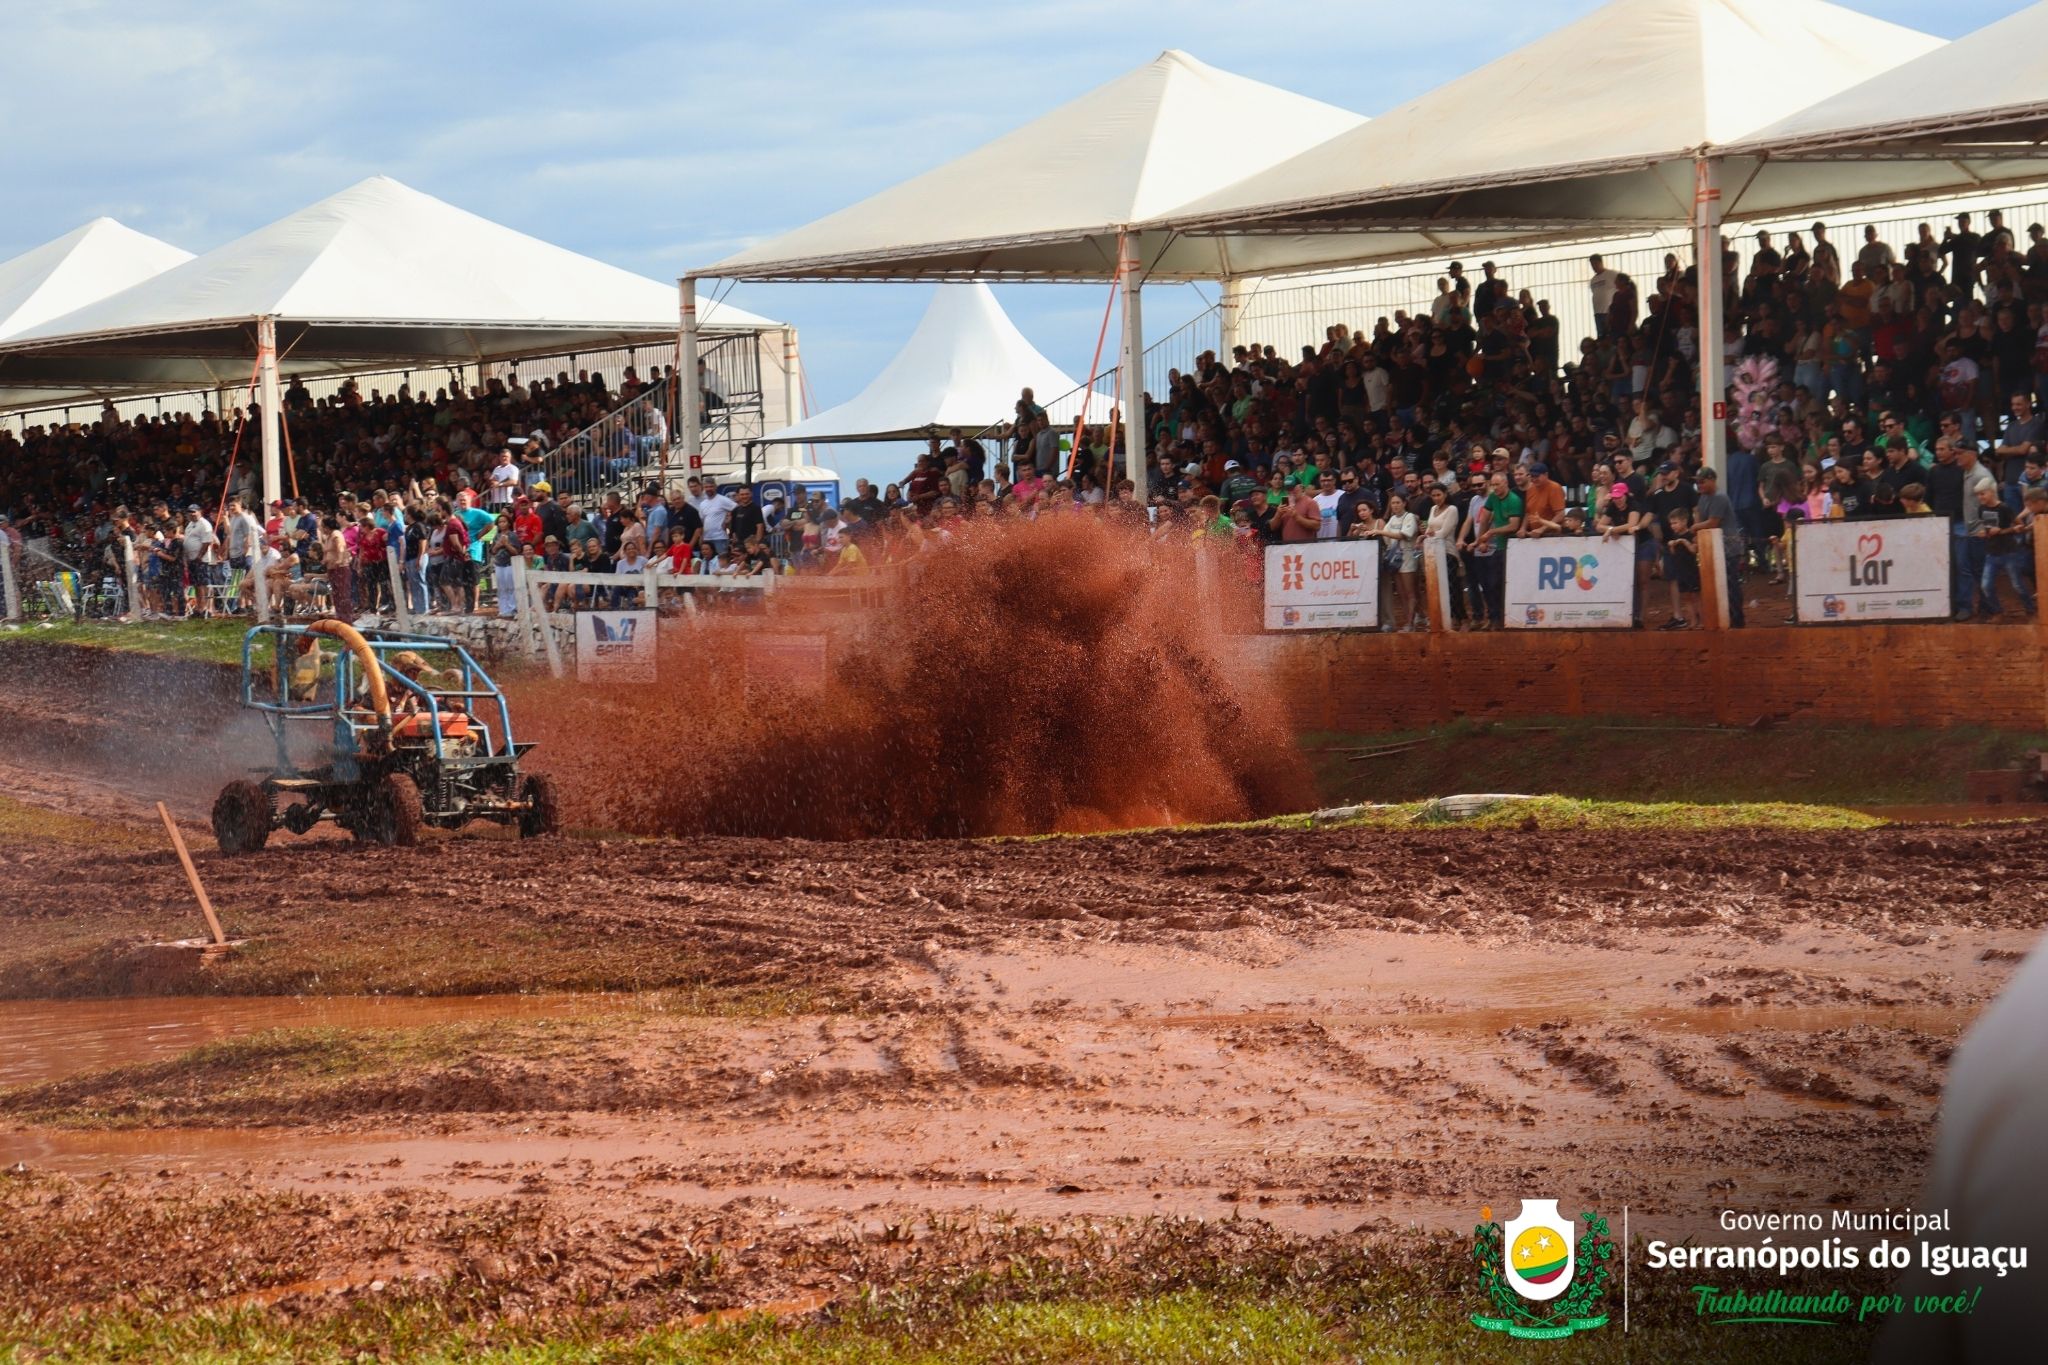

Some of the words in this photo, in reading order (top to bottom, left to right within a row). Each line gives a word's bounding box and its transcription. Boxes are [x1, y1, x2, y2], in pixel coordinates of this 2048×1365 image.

[1310, 560, 1360, 581] COPEL
[1538, 554, 1598, 591] RPC
[1849, 554, 1893, 586] Lar
